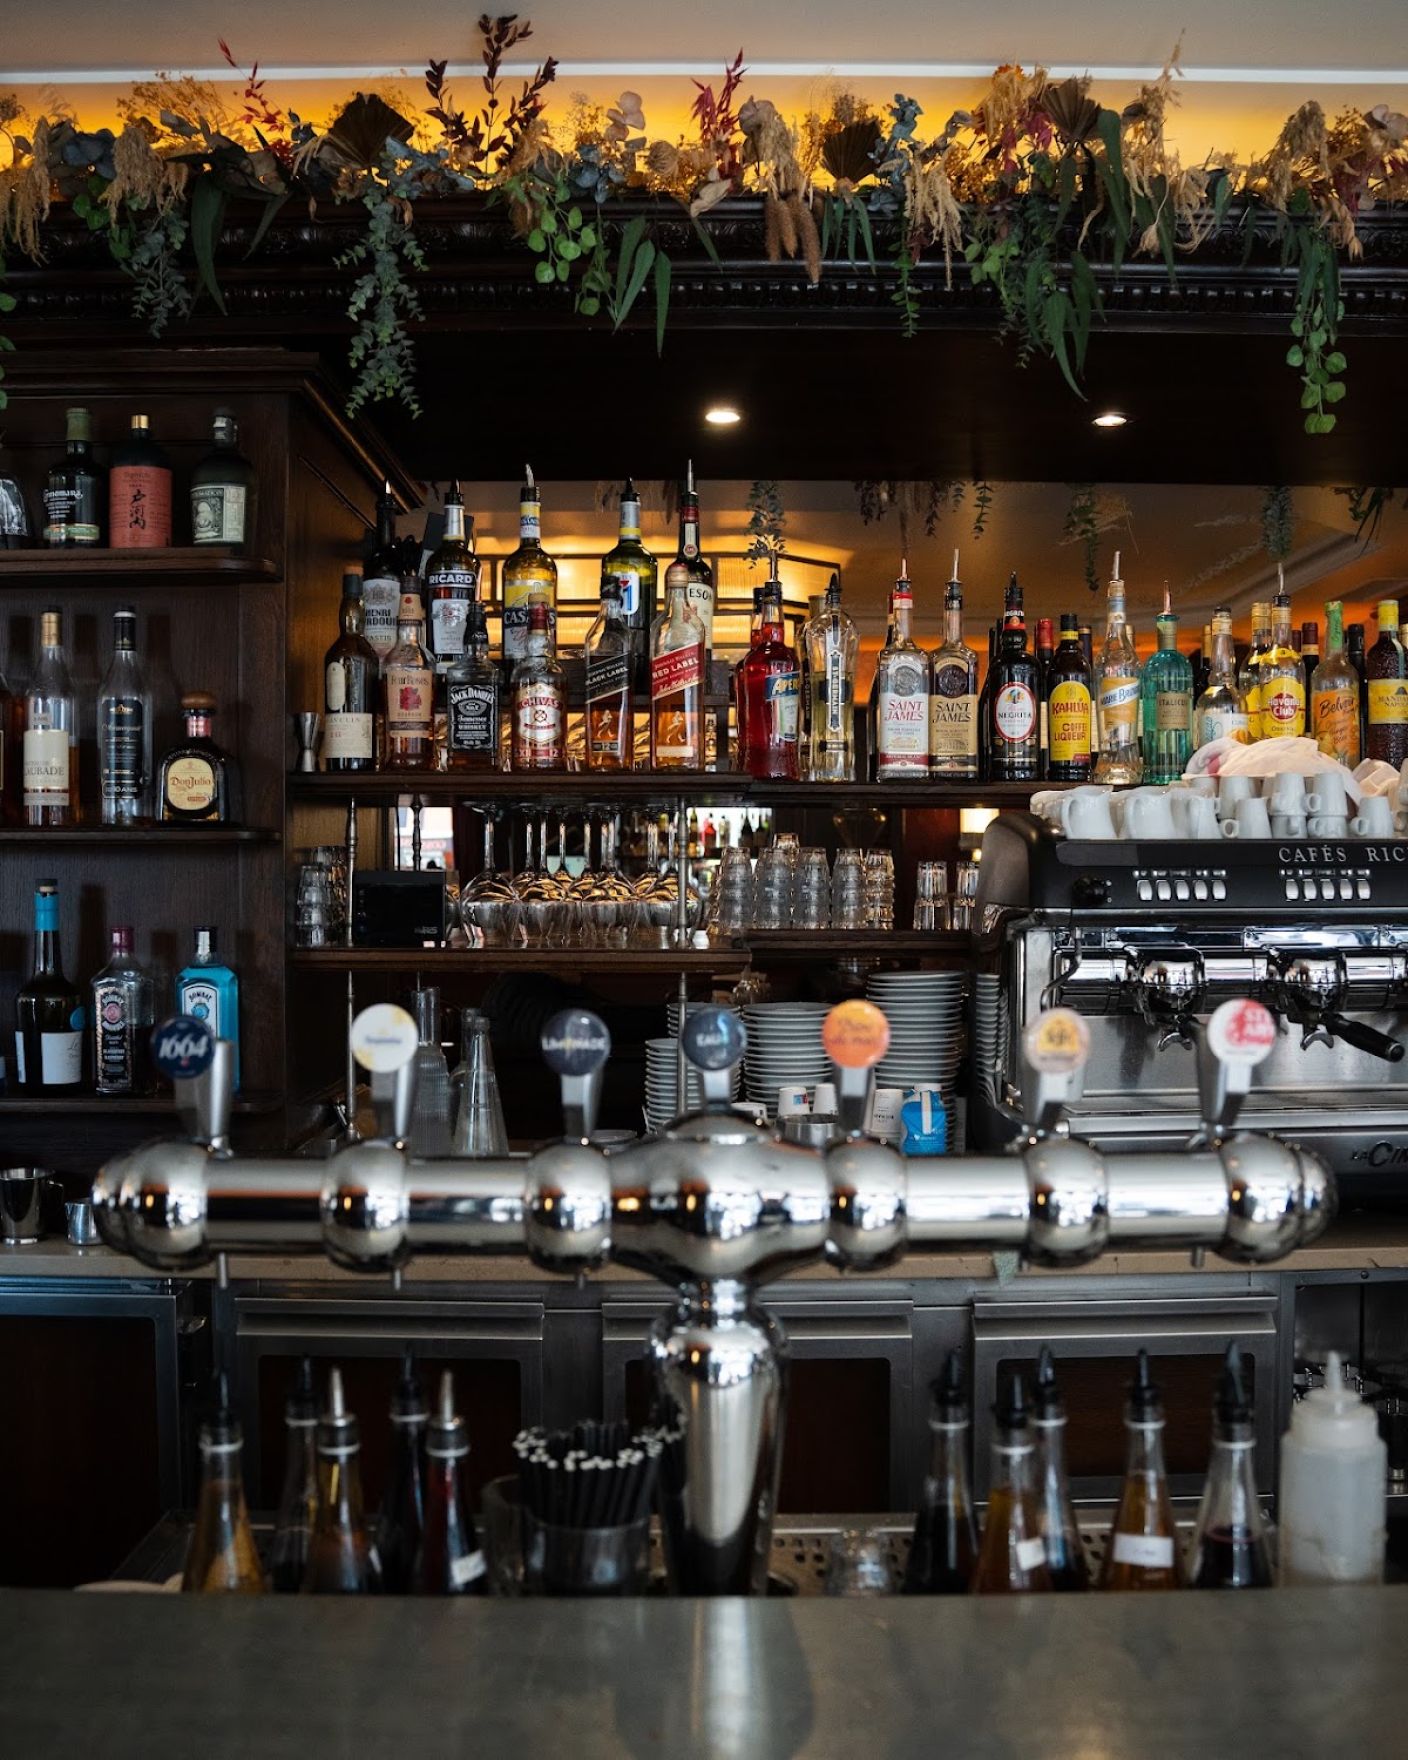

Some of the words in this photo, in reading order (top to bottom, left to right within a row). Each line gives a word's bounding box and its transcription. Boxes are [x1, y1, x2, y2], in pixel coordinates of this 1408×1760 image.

[428, 573, 473, 585] RICARD
[365, 608, 392, 617] HENRI
[504, 611, 556, 625] CASS
[606, 666, 629, 678] LABEL
[652, 668, 670, 679] RED
[671, 657, 699, 672] LABEL
[771, 678, 799, 696] APER
[451, 689, 468, 704] JACK
[521, 697, 560, 708] CHIVAS
[888, 699, 925, 711] SAINT
[936, 701, 972, 713] SAINT
[1052, 698, 1089, 715] KAHLÚA
[1274, 705, 1295, 716] Club
[884, 710, 924, 721] JAMES
[932, 712, 971, 723] JAMES
[998, 711, 1032, 719] NEGRITA
[1054, 731, 1087, 741] LIQUEUR
[1279, 845, 1347, 862] CAFÉS
[1365, 847, 1408, 862] RIC
[189, 991, 212, 1003] BOMBAY
[159, 1033, 208, 1059] 1664
